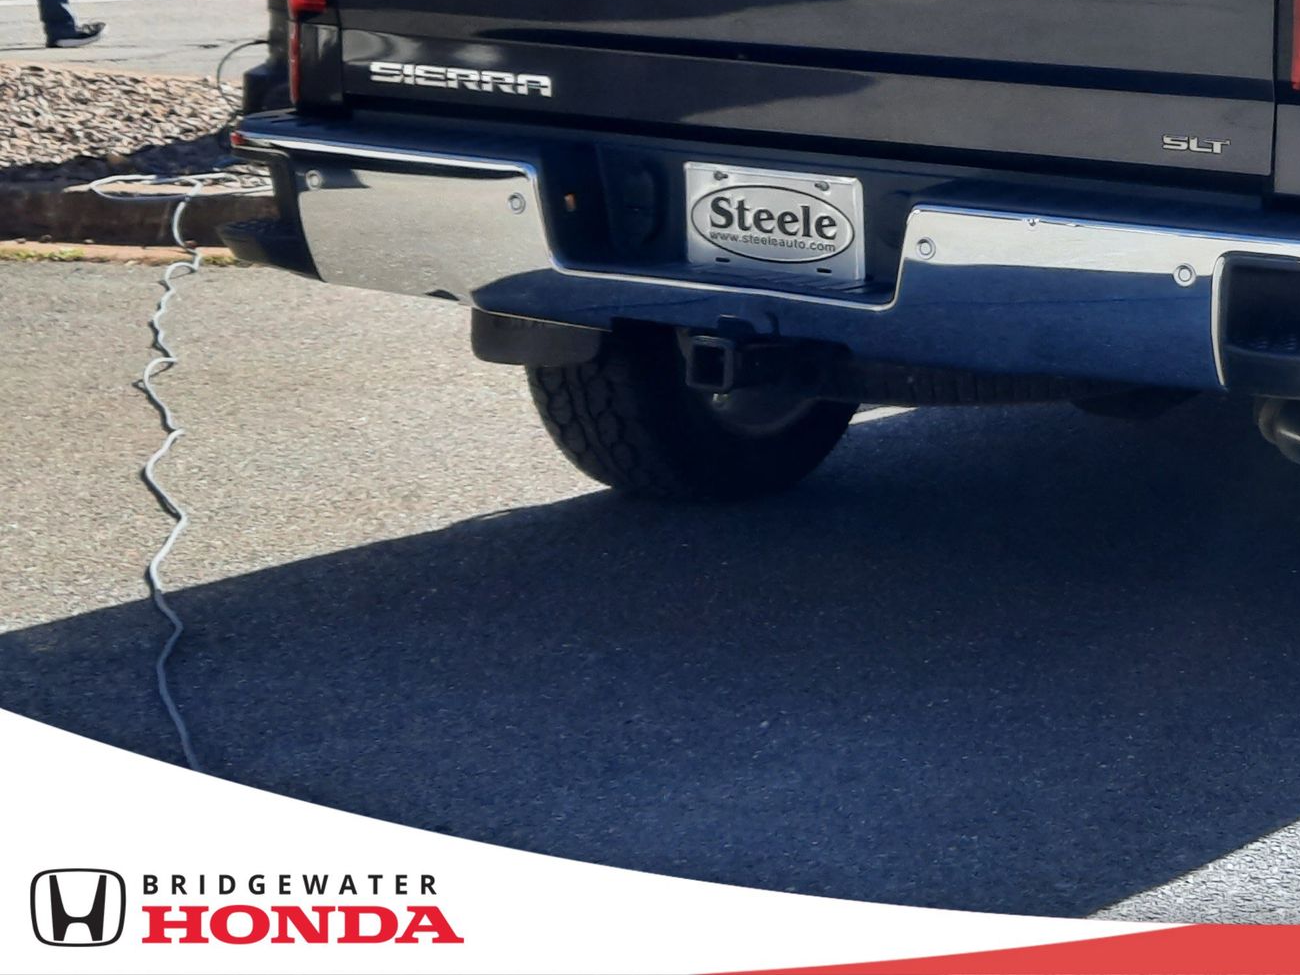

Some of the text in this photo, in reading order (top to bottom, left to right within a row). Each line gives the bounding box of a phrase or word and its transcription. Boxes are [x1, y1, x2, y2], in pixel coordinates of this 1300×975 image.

[370, 61, 552, 98] SIERRA
[1162, 134, 1231, 154] SLT
[710, 196, 837, 241] Steele
[709, 231, 836, 252] www.steeleauto.com
